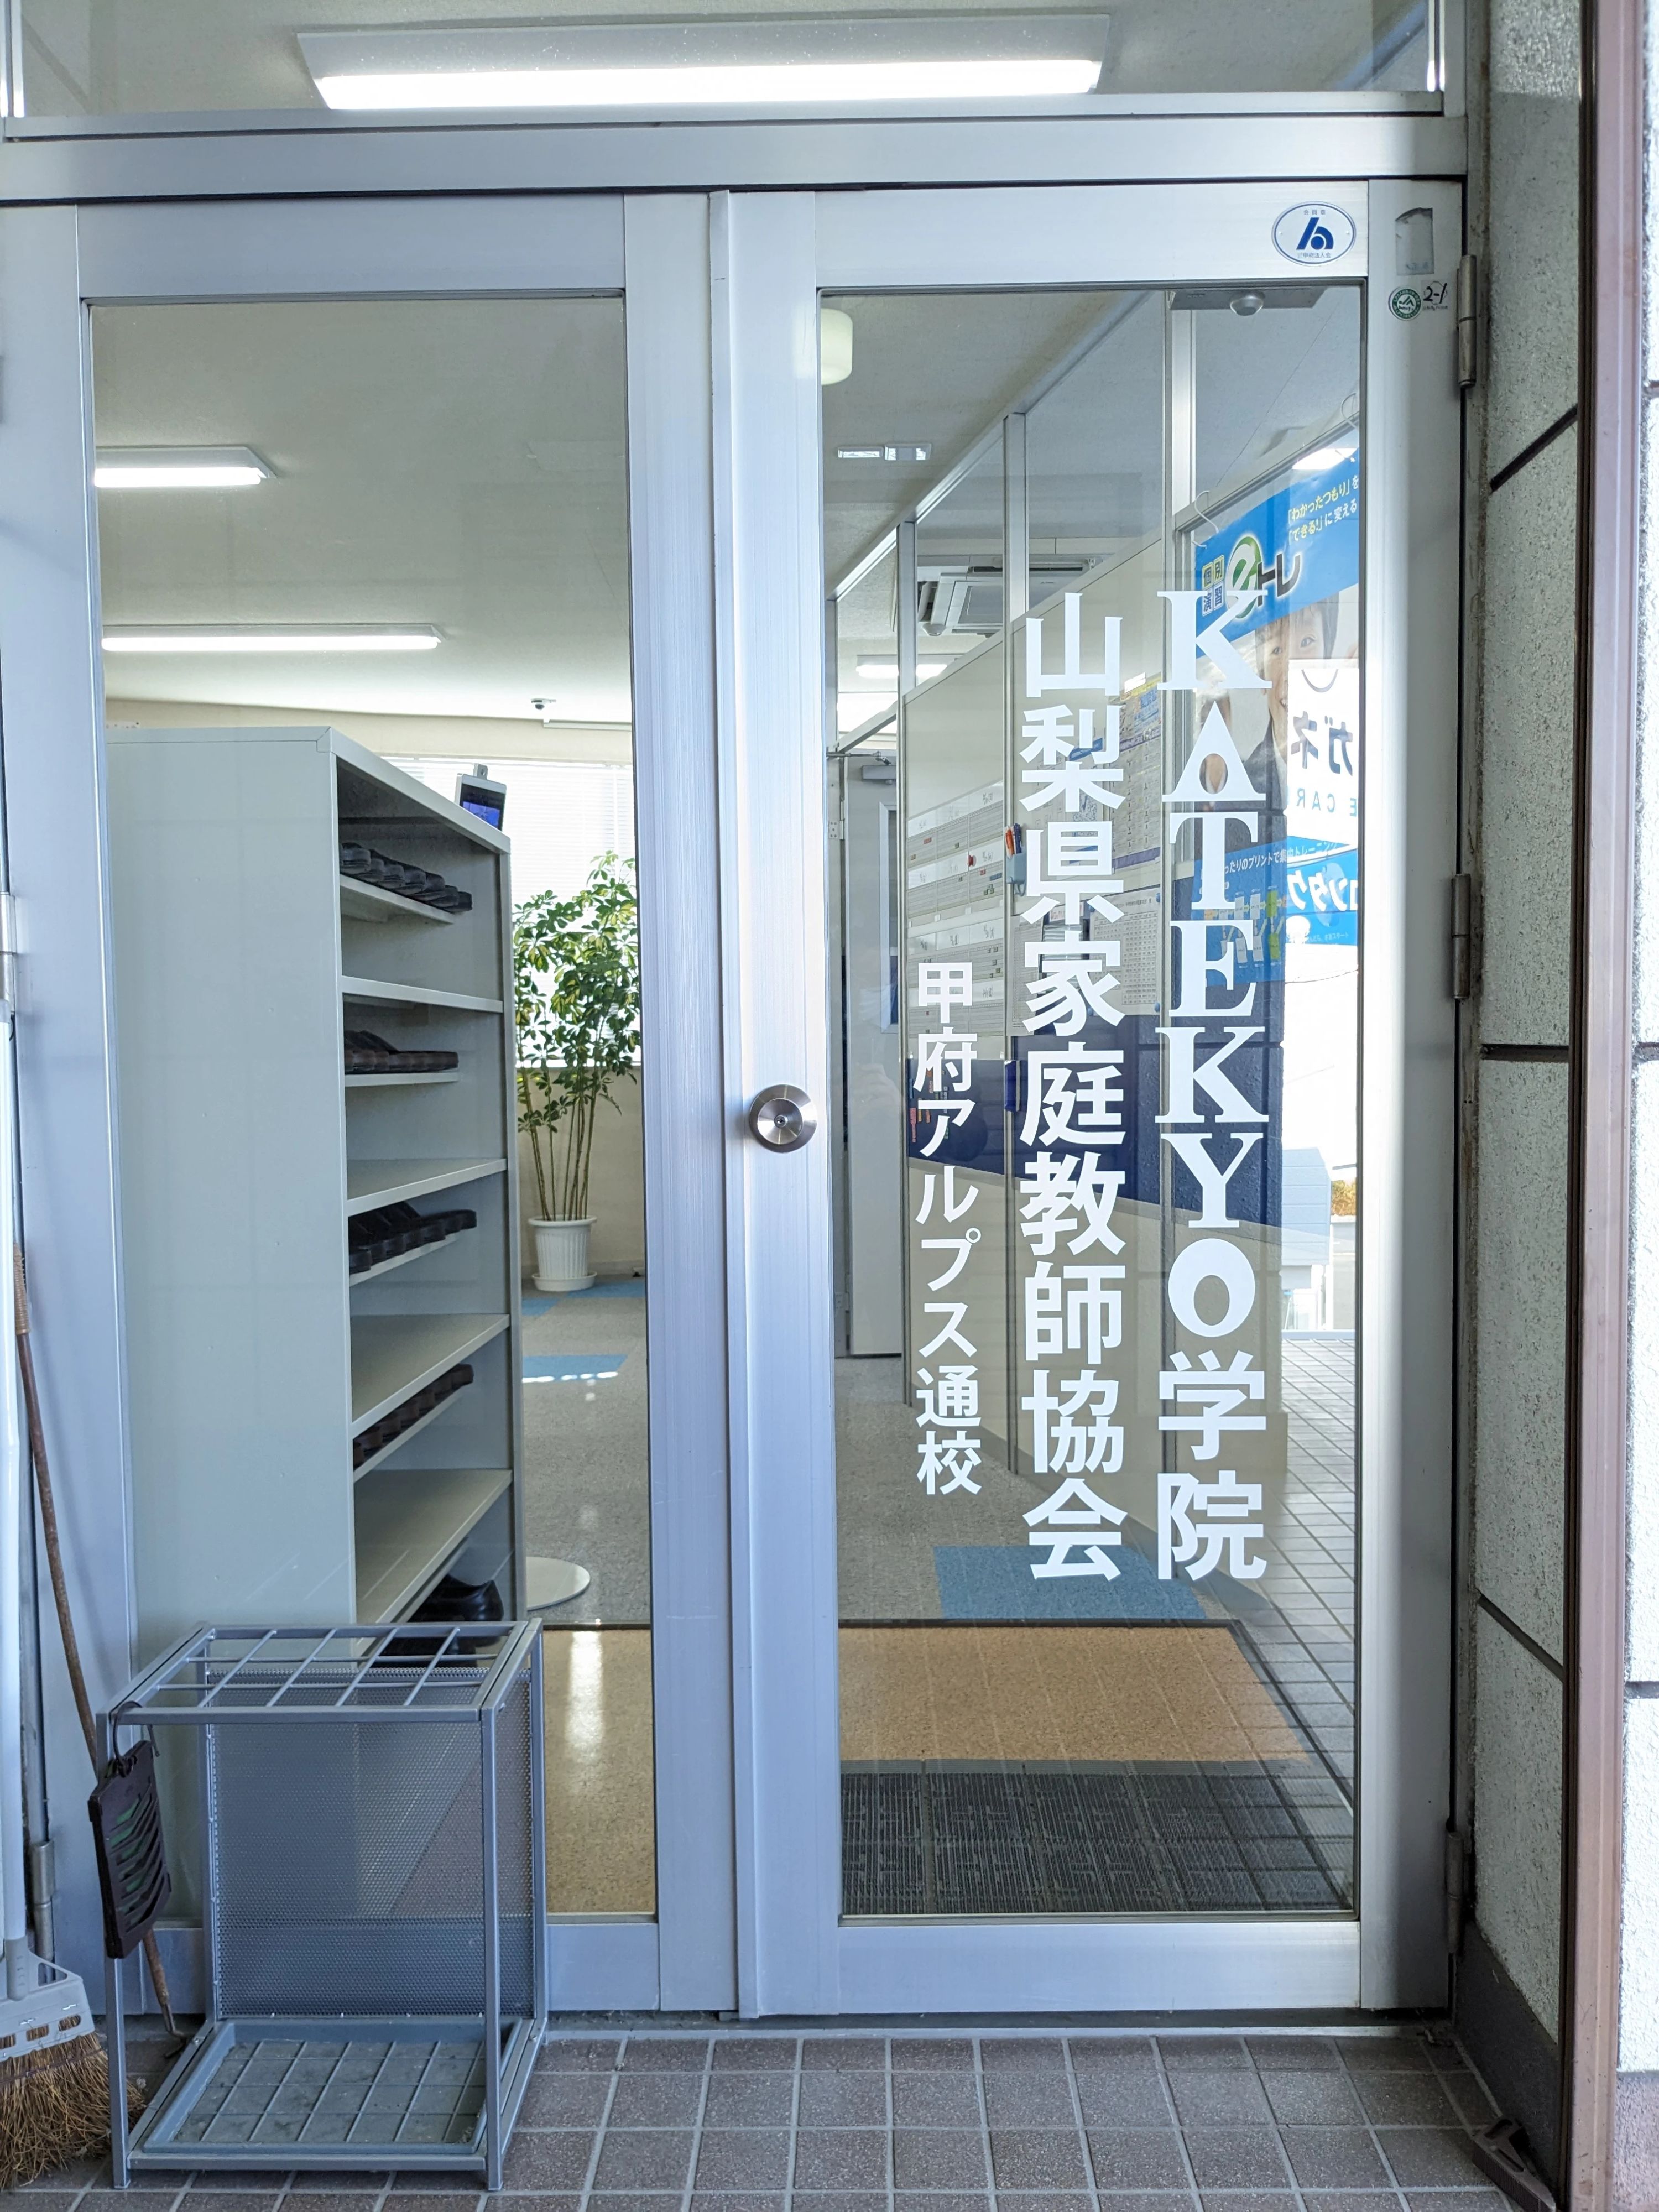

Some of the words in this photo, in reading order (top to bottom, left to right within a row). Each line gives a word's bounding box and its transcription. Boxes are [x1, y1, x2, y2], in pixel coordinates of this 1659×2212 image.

[1423, 283, 1447, 304] 2-1
[1019, 592, 1128, 1582] 山梨県家庭教師協会
[1155, 591, 1272, 1581] KATEKYO学院
[1201, 842, 1338, 879] ったりのプリントで集中トレーニン
[913, 962, 982, 1495] 甲府アルプス通校
